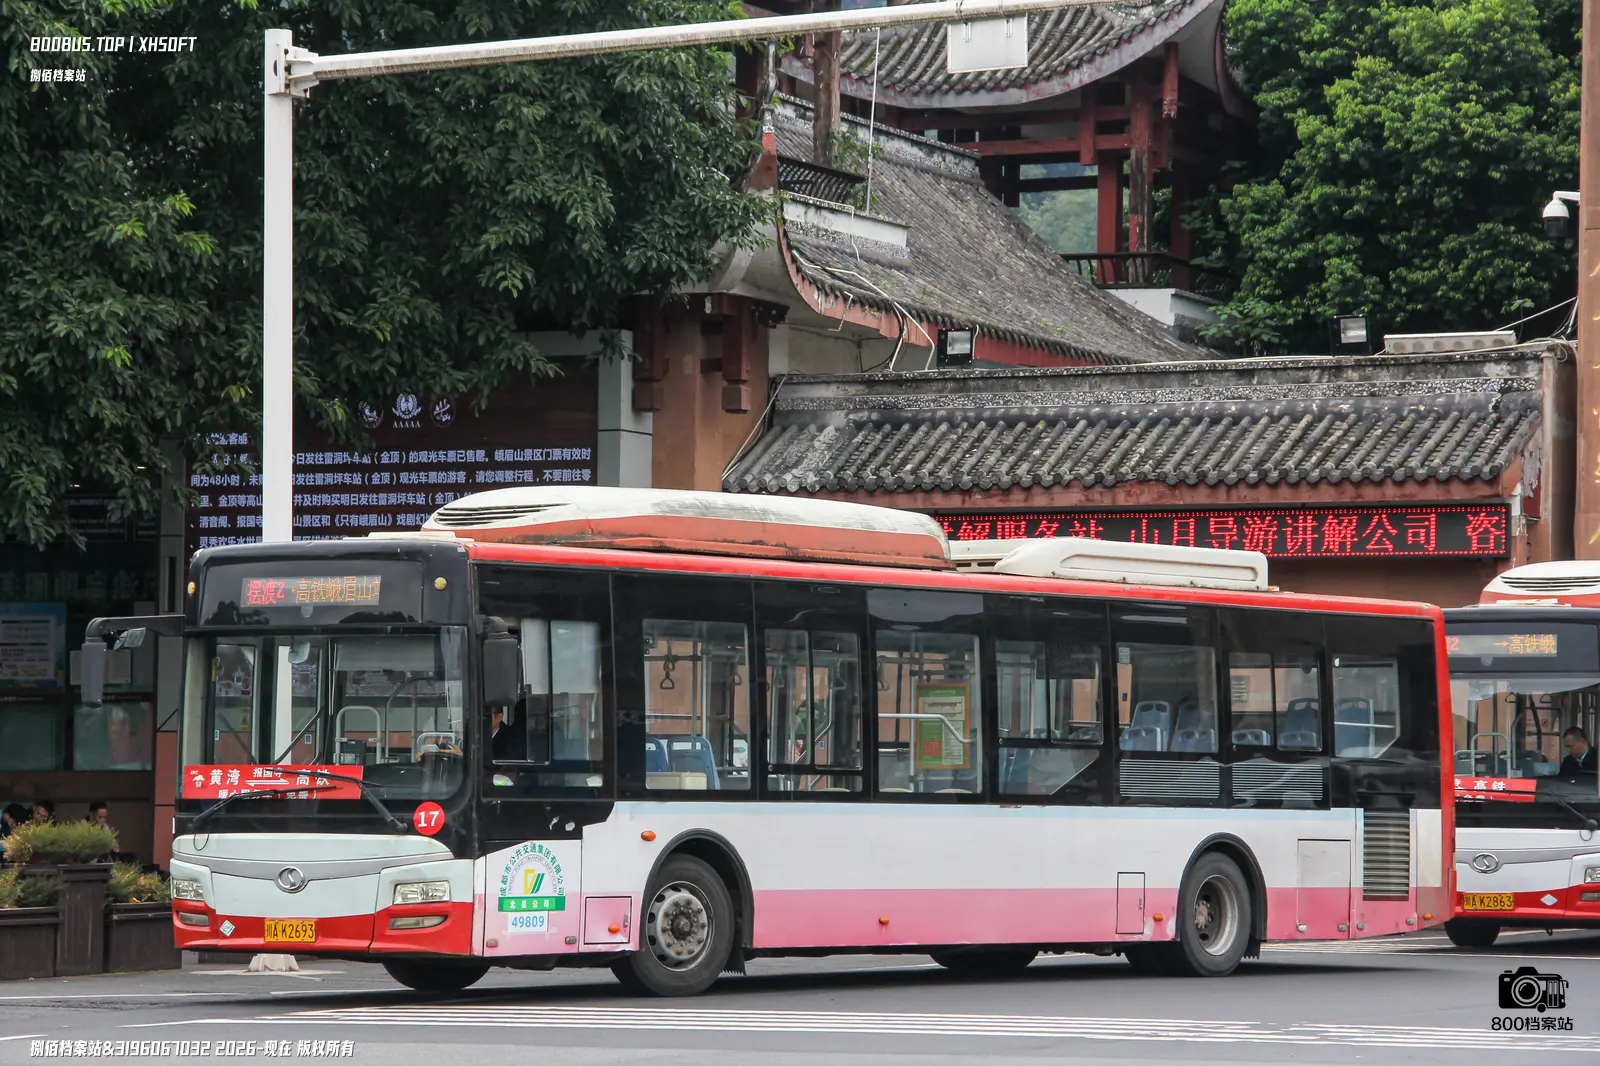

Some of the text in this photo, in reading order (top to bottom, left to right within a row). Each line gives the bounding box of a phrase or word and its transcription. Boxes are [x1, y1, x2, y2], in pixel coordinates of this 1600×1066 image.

[209, 768, 240, 786] 黄湾
[417, 811, 439, 828] 17
[511, 915, 545, 928] 49809
